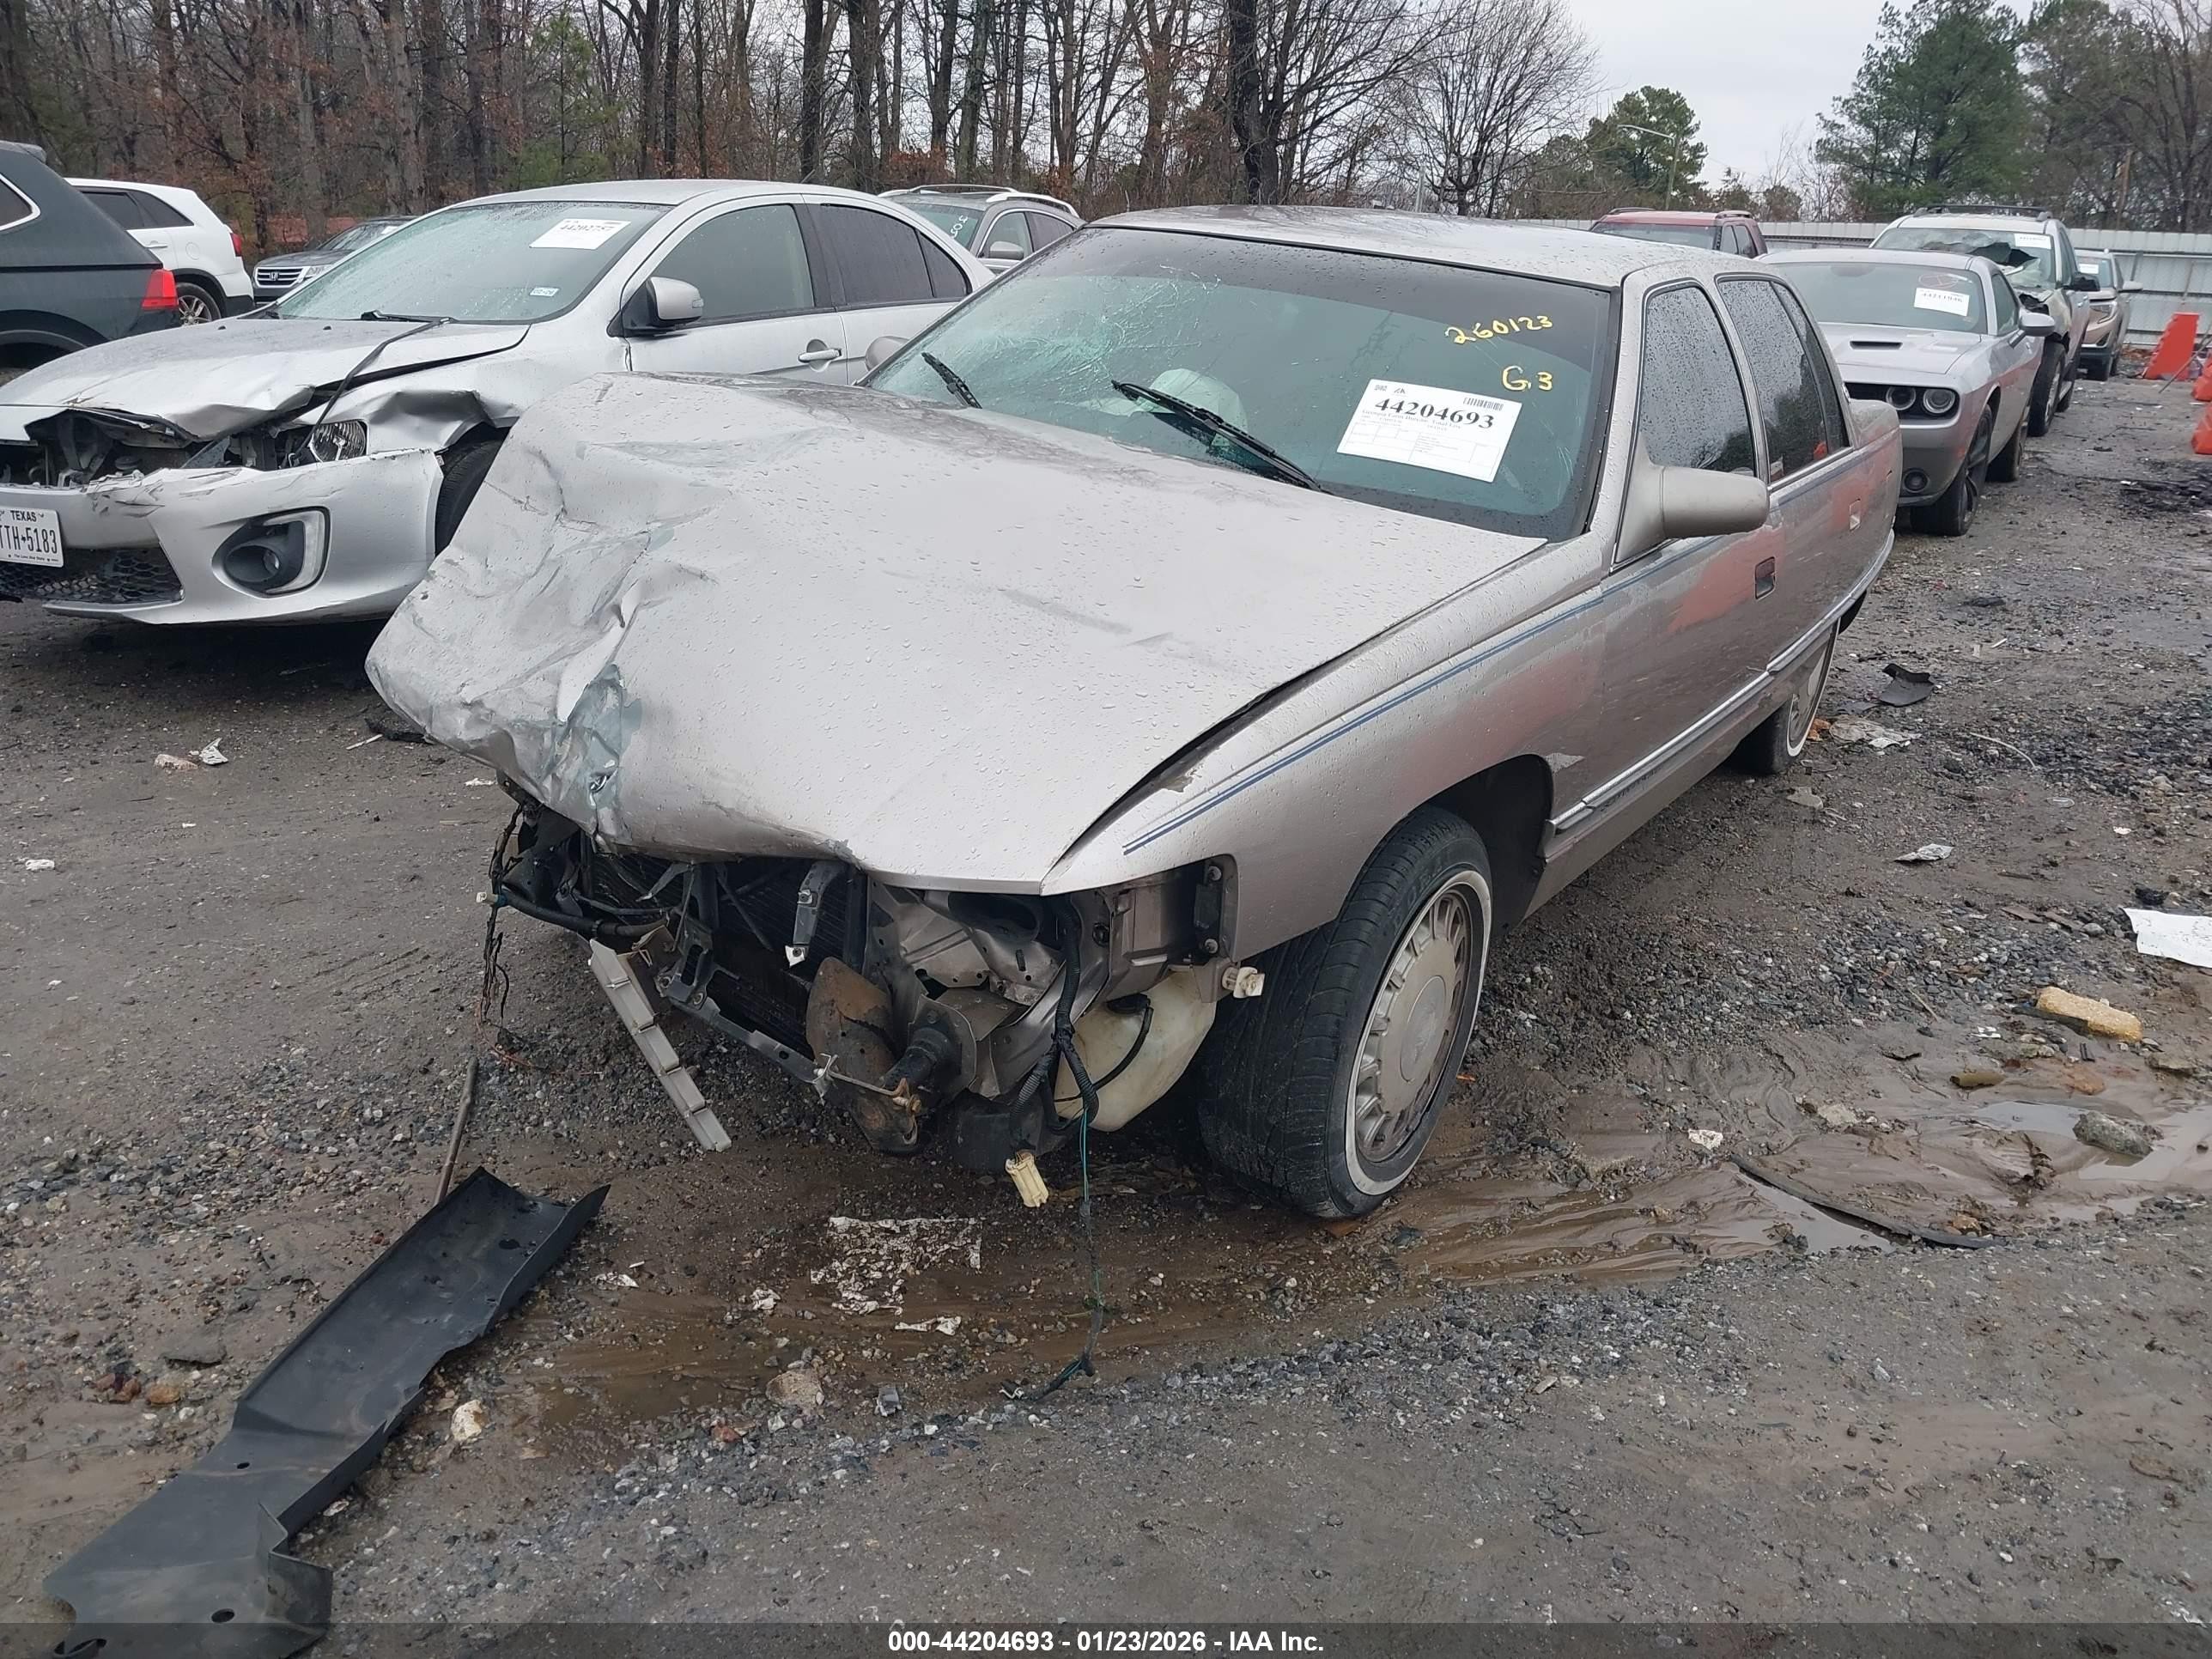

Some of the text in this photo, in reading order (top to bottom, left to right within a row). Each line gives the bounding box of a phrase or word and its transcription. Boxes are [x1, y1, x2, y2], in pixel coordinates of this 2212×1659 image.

[1445, 315, 1553, 343] 260123
[1375, 398, 1495, 429] 44204693
[10, 510, 37, 522] TEXAS
